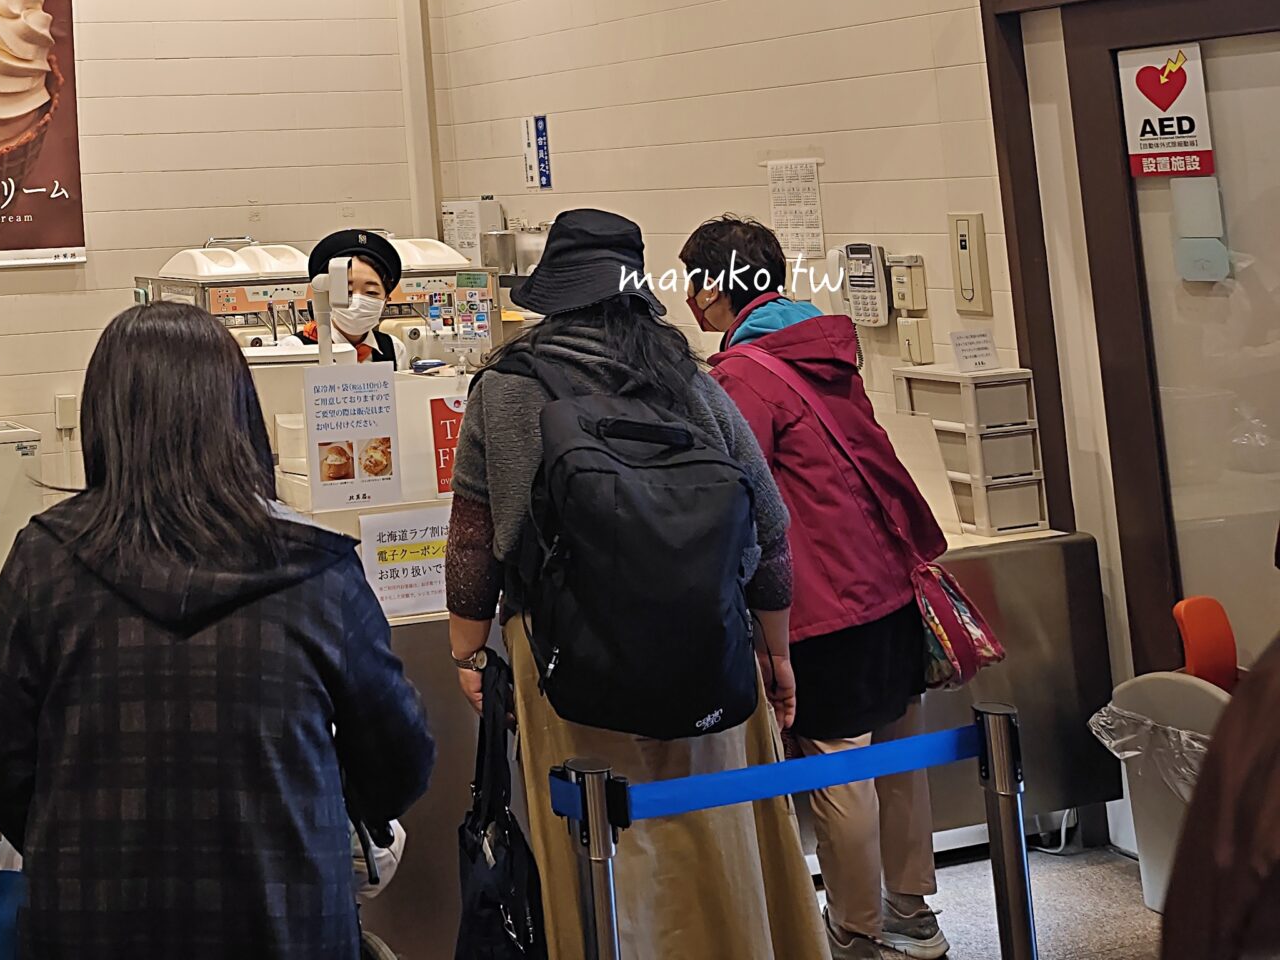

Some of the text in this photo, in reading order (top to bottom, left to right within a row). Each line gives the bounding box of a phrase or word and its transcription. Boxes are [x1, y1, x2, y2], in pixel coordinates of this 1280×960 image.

[1139, 115, 1196, 138] AED
[1142, 155, 1201, 173] 設置施設
[314, 393, 390, 406] ご用意しておりますので
[378, 563, 446, 580] お取り扱いで
